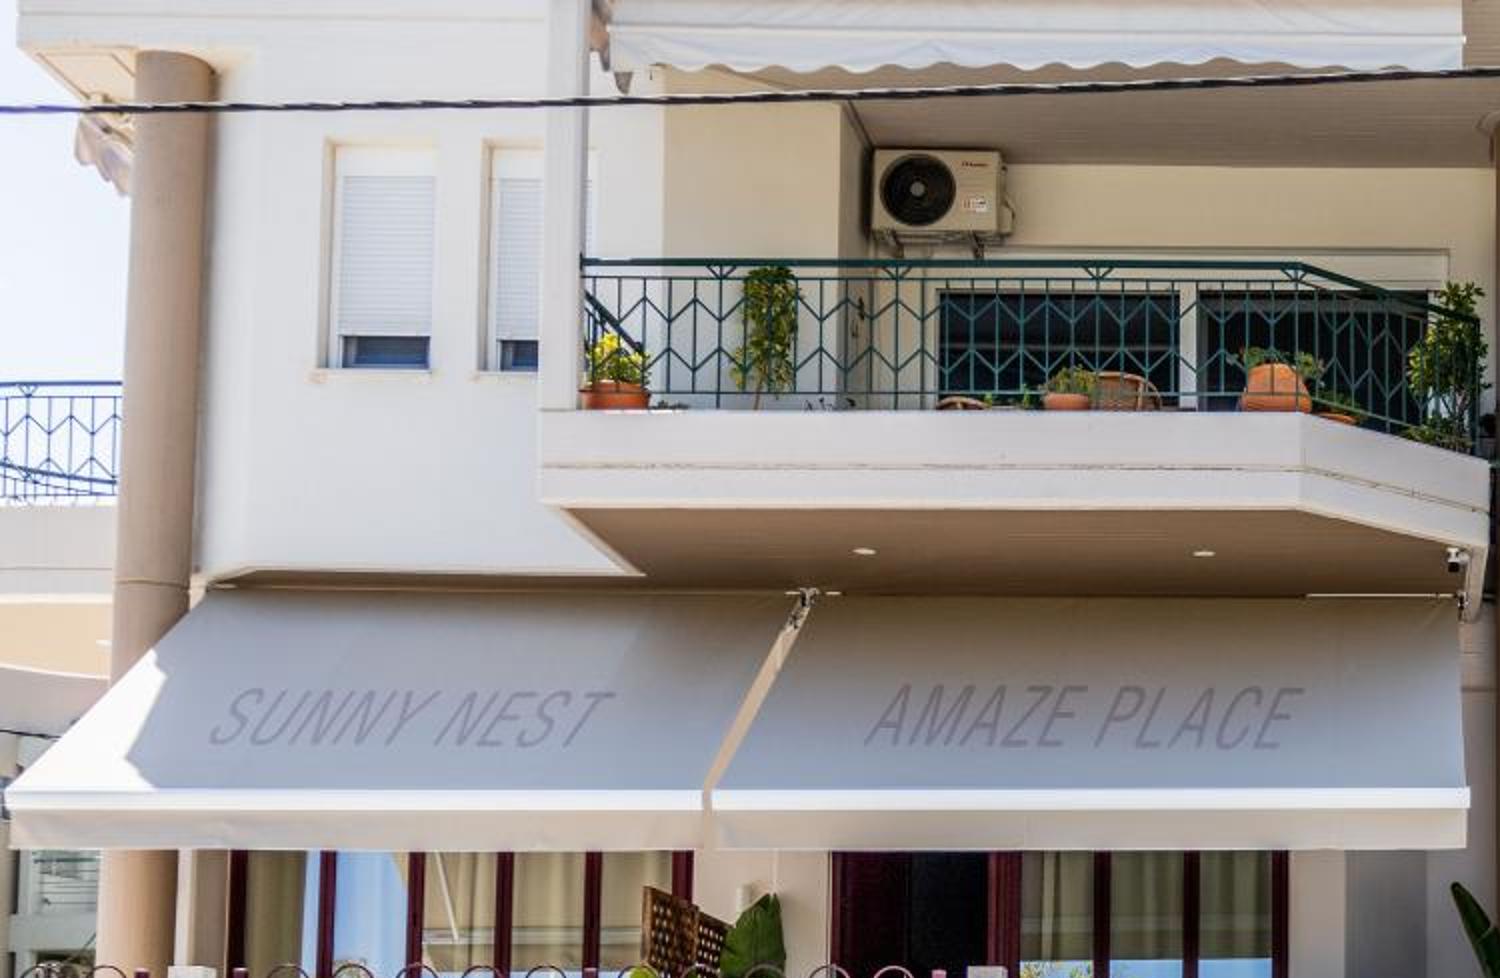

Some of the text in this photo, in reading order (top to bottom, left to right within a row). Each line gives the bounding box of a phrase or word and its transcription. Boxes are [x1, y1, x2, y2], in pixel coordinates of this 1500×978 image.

[209, 687, 616, 748] SUNNY NEST
[864, 684, 1304, 750] AMAZE PLACE
